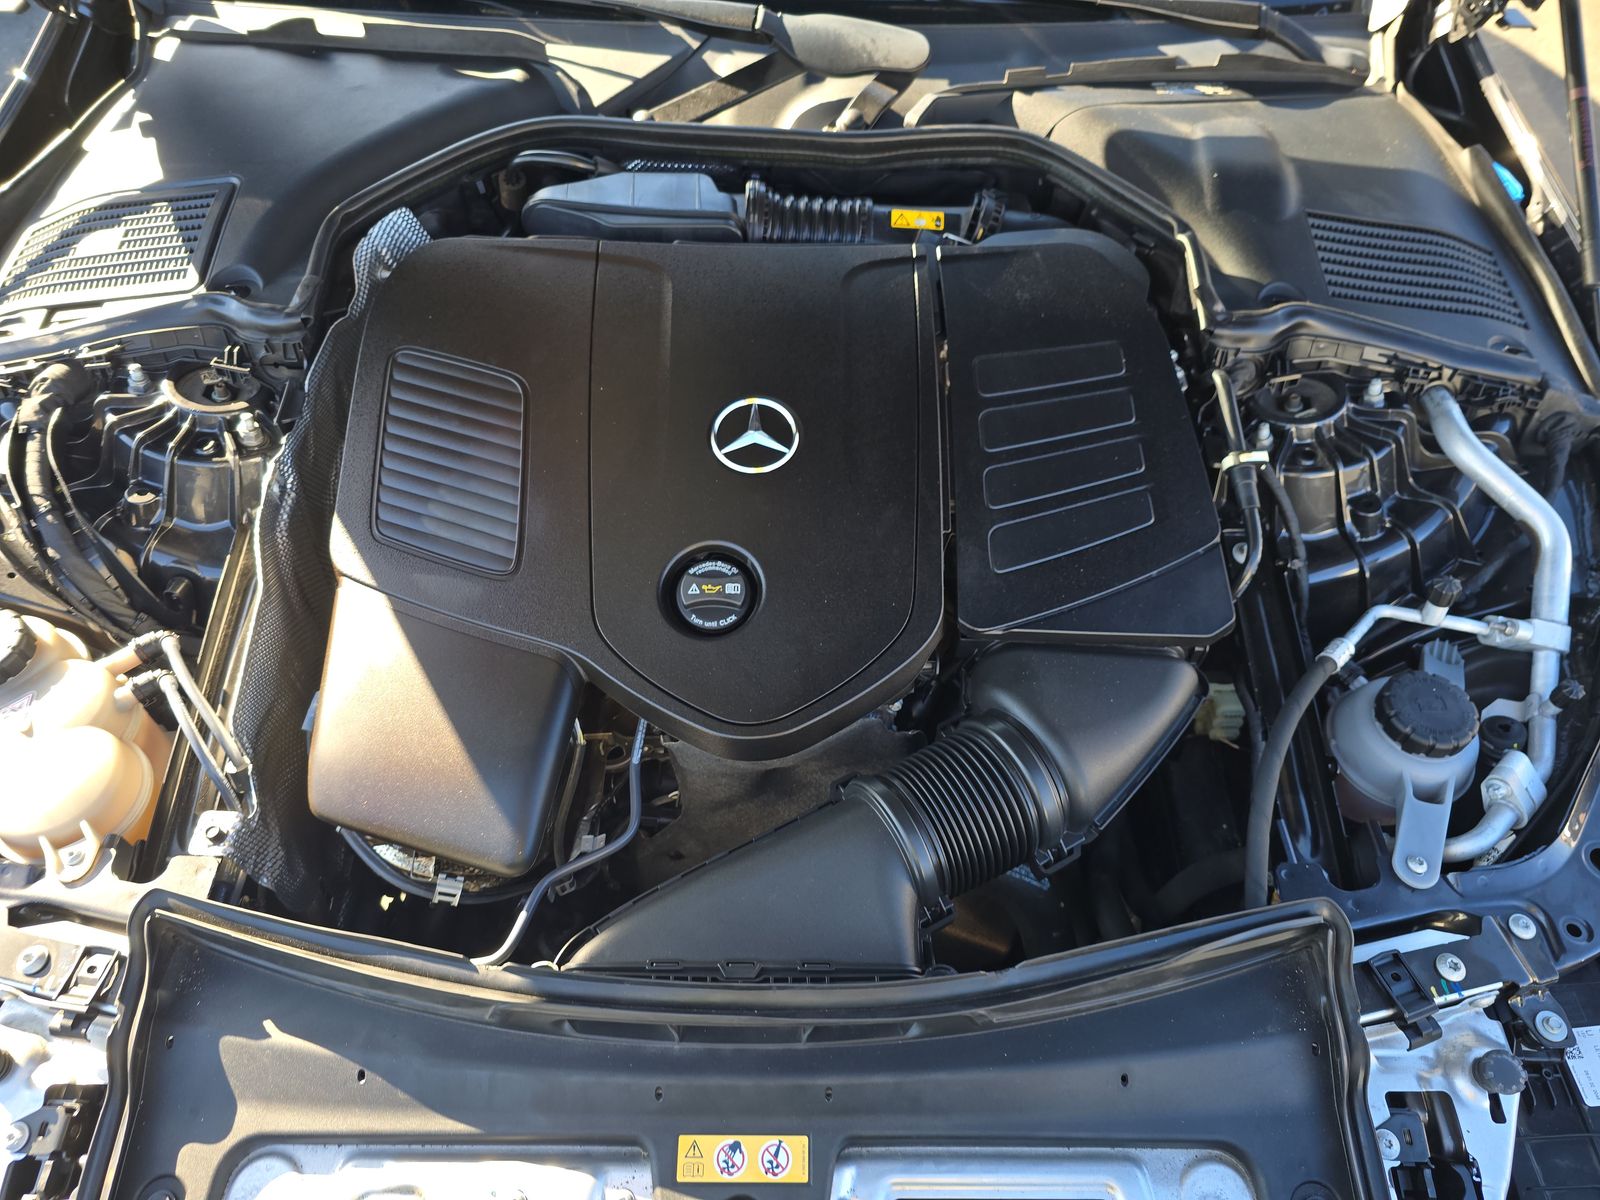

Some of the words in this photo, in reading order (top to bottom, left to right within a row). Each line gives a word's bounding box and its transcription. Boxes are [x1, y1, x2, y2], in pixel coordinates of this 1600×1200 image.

[688, 561, 731, 574] Mercedes-Benz
[696, 566, 733, 575] recommended
[691, 613, 703, 625] Turn
[719, 613, 737, 626] CLICK
